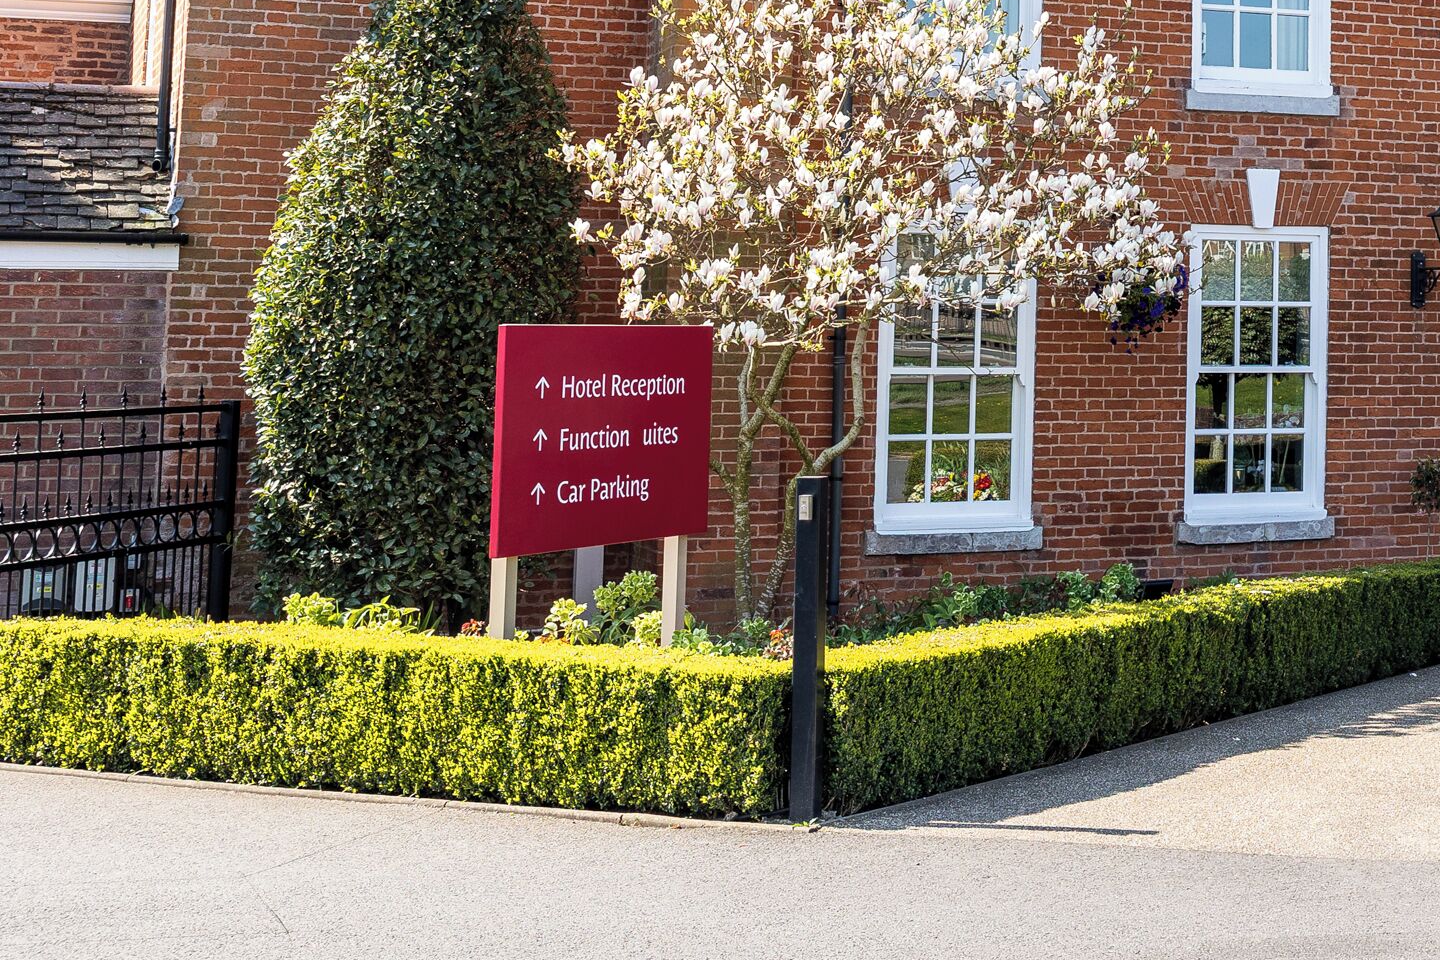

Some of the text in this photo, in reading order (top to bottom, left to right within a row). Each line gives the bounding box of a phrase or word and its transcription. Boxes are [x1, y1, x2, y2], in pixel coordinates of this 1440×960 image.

[561, 373, 686, 401] Hotel Reception
[559, 424, 630, 452] Function
[556, 474, 650, 504] Car Parking
